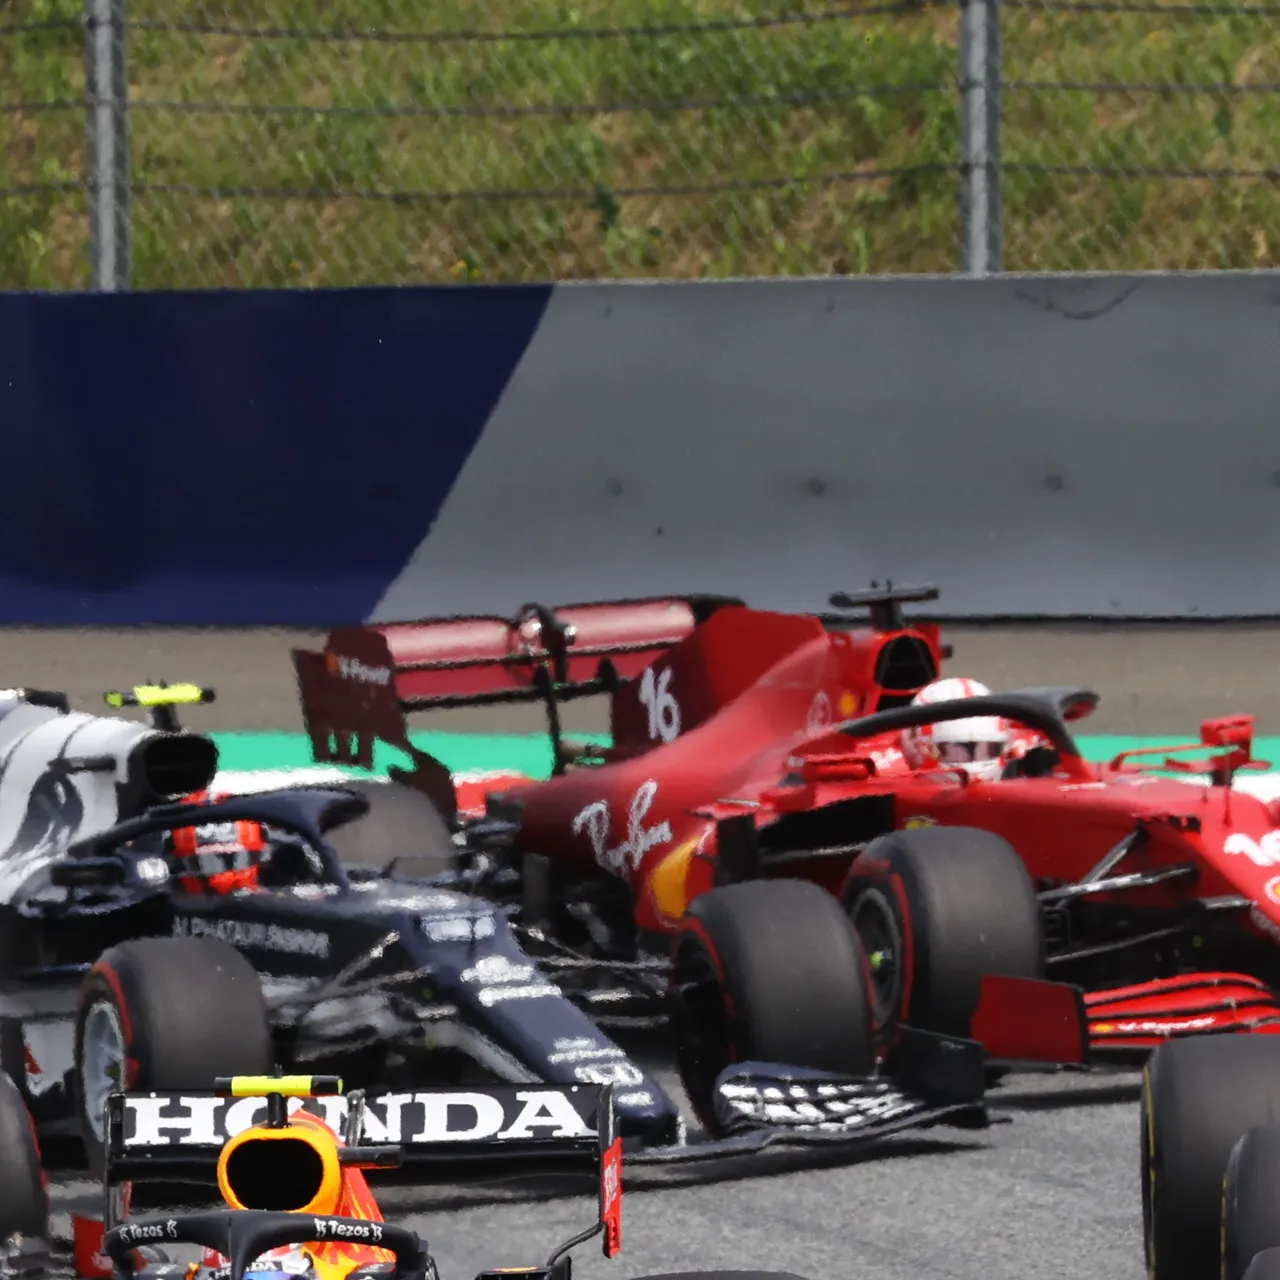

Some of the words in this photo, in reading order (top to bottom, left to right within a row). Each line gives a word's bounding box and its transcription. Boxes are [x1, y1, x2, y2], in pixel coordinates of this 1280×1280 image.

[639, 666, 681, 743] 16
[124, 1088, 600, 1146] HONDA
[330, 1221, 370, 1238] Tezos
